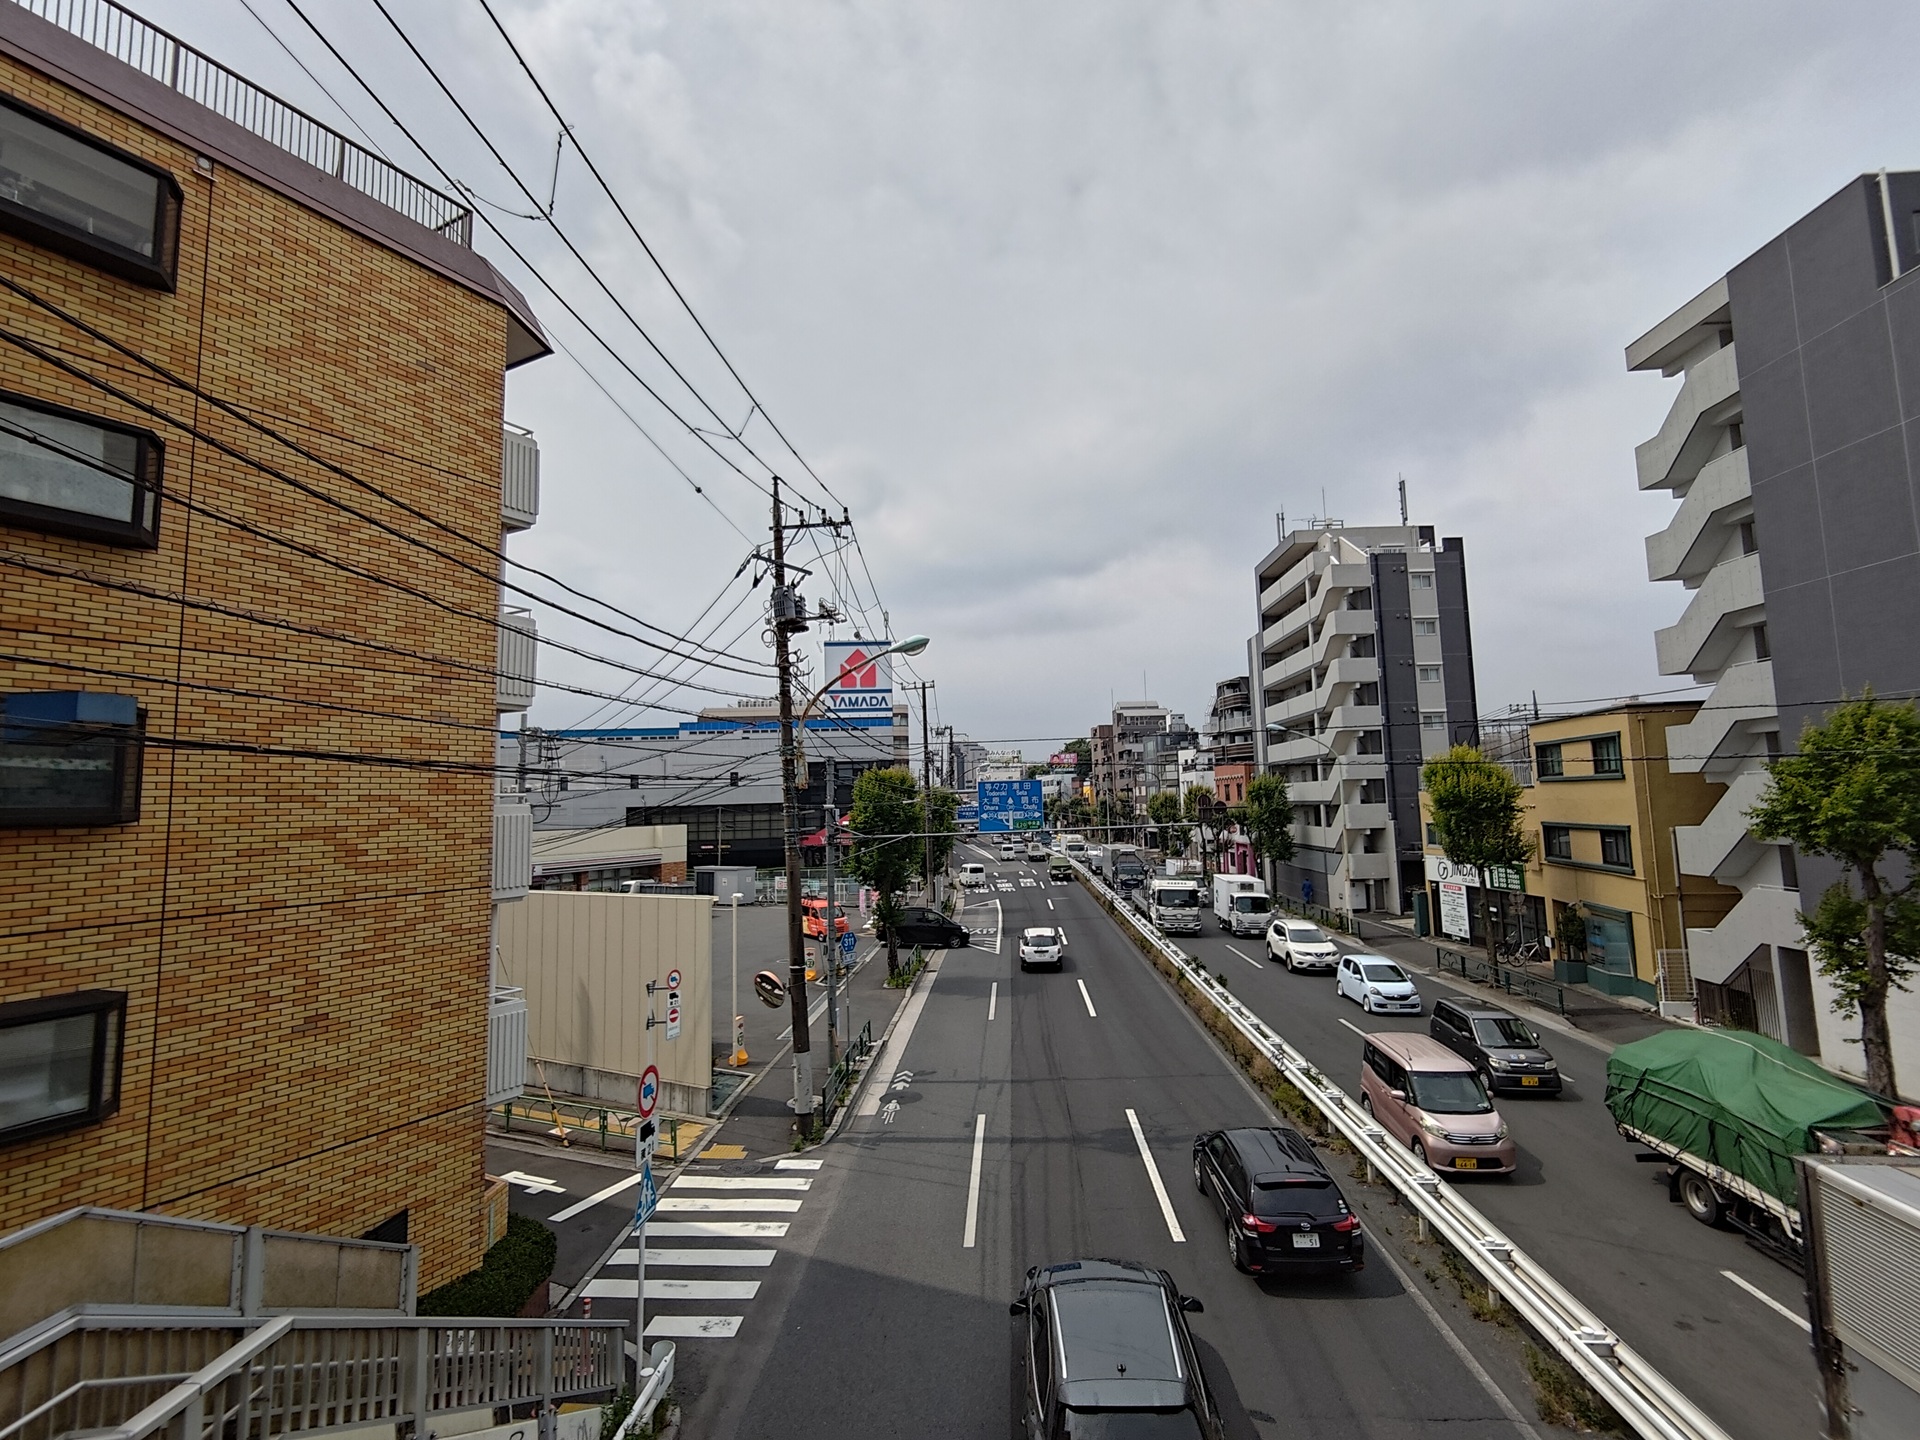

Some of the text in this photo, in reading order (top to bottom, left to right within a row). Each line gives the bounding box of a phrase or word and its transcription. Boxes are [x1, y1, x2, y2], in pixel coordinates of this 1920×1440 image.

[829, 695, 889, 708] YAMADA
[985, 783, 1008, 791] 等々力
[982, 797, 1000, 805] 大原
[1021, 796, 1039, 804] 調布
[843, 937, 855, 947] 311
[1309, 1238, 1318, 1247] 51
